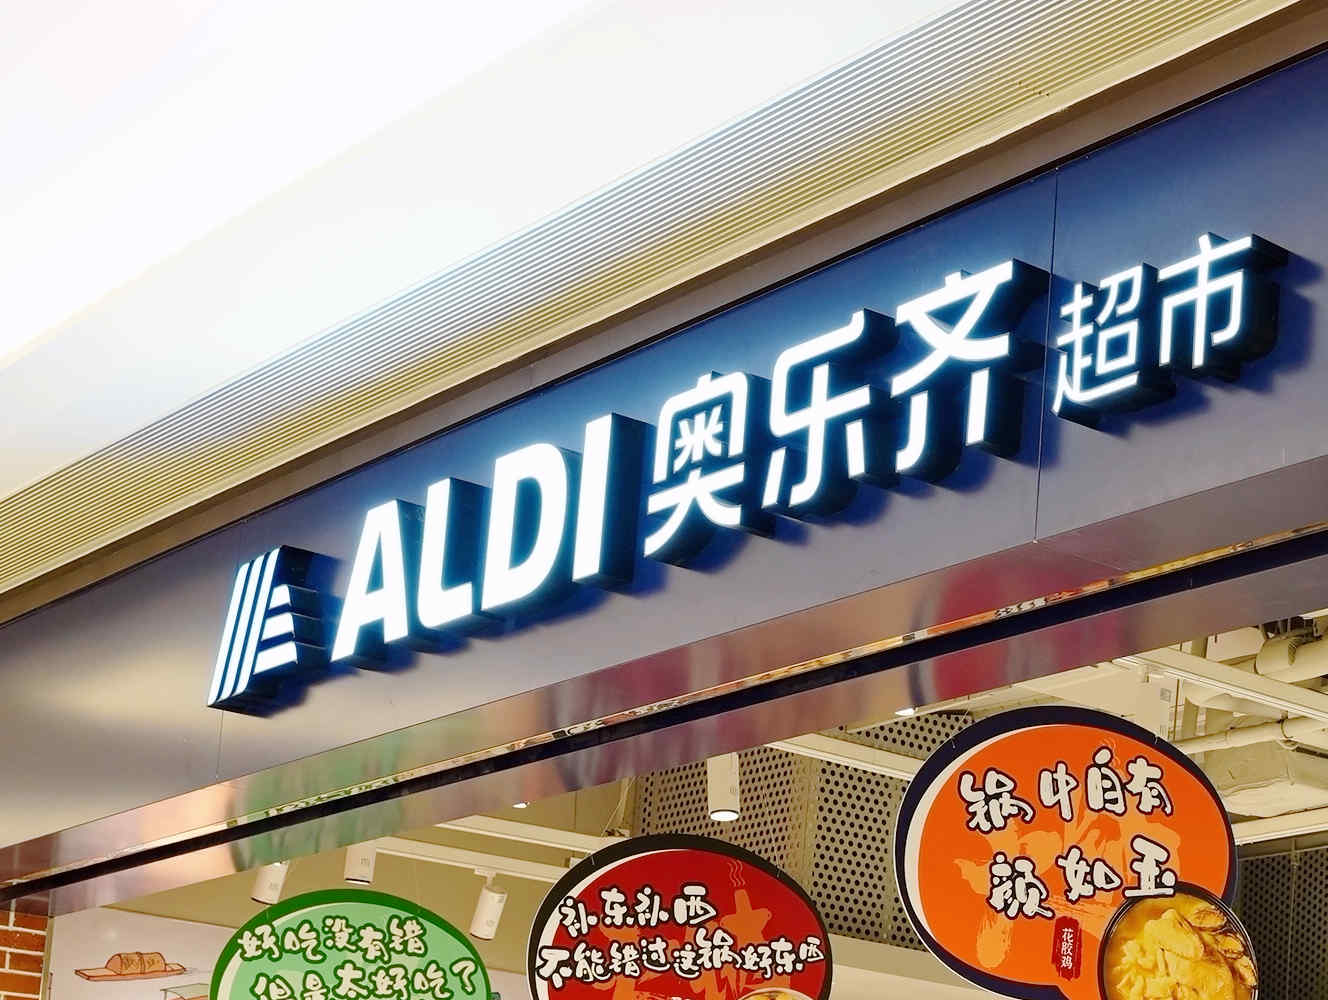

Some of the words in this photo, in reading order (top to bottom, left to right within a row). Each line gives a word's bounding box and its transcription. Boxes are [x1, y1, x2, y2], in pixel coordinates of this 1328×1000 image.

[331, 414, 612, 664] ALDI
[644, 260, 1014, 555] 奥乐齐
[1052, 233, 1253, 415] 超市
[959, 747, 1173, 834] 锅中自有
[986, 835, 1178, 919] 颜如玉
[238, 916, 426, 962] 好吃没有错
[560, 883, 717, 938] 补东补西
[536, 927, 825, 989] 不能错过这锅好东西
[1060, 927, 1074, 969] 花胶鸡
